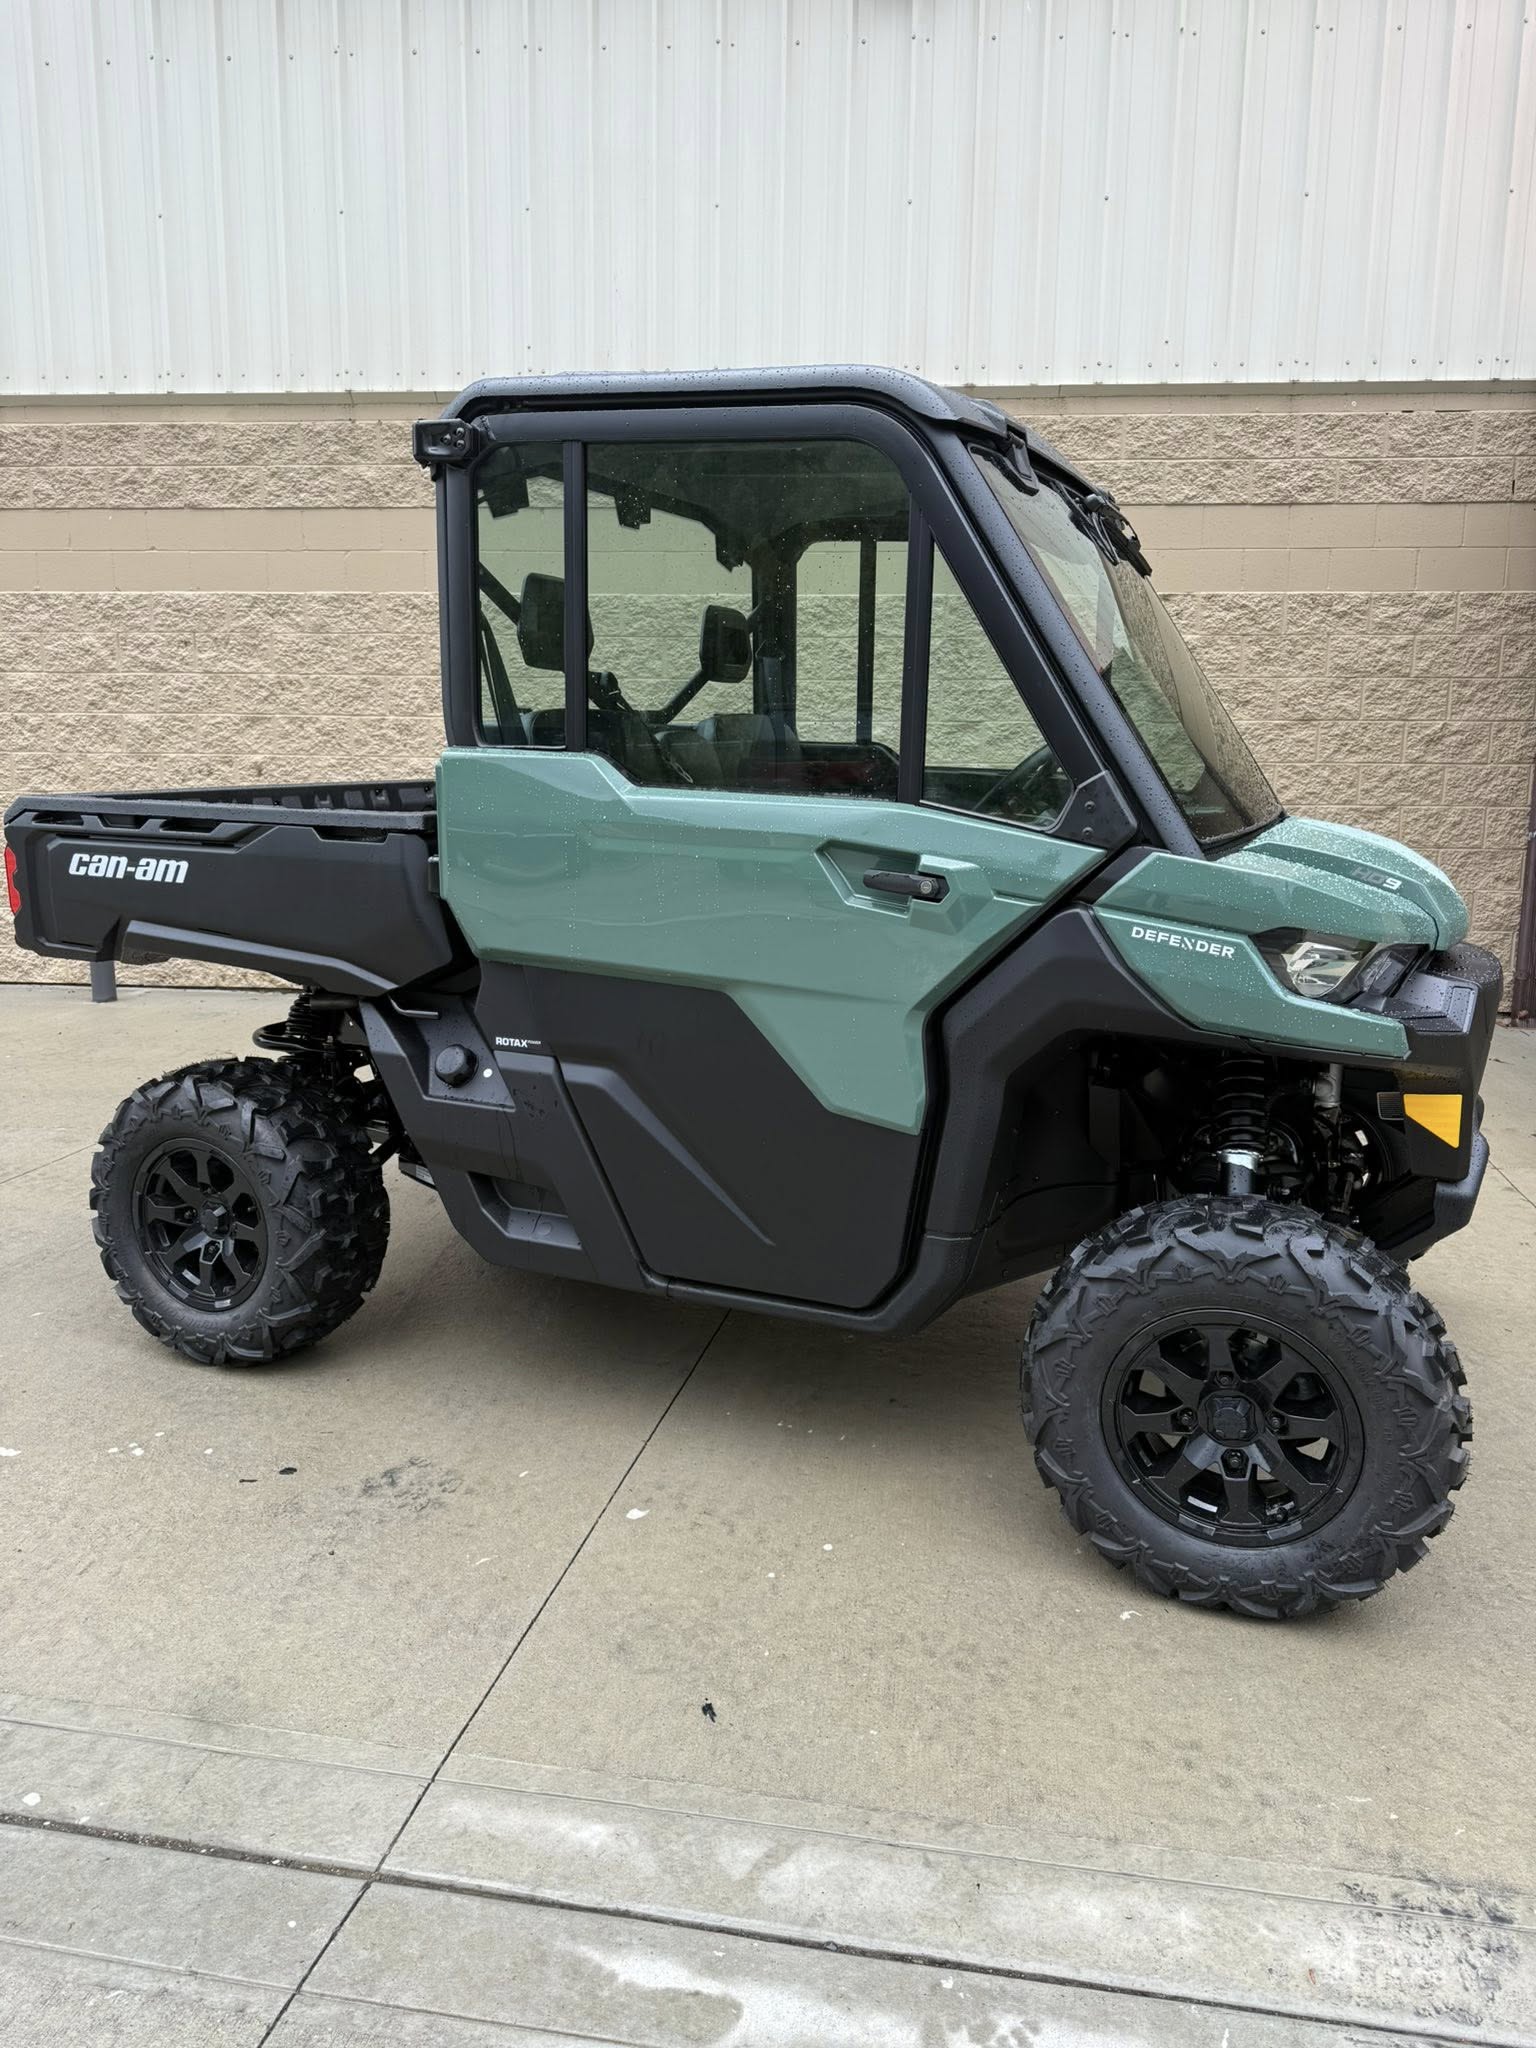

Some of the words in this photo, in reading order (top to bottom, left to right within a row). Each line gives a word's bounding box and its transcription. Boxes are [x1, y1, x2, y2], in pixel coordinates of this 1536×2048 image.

[68, 853, 189, 884] can-am
[1131, 926, 1235, 959] DEFENDER
[495, 1036, 528, 1048] ROTAX
